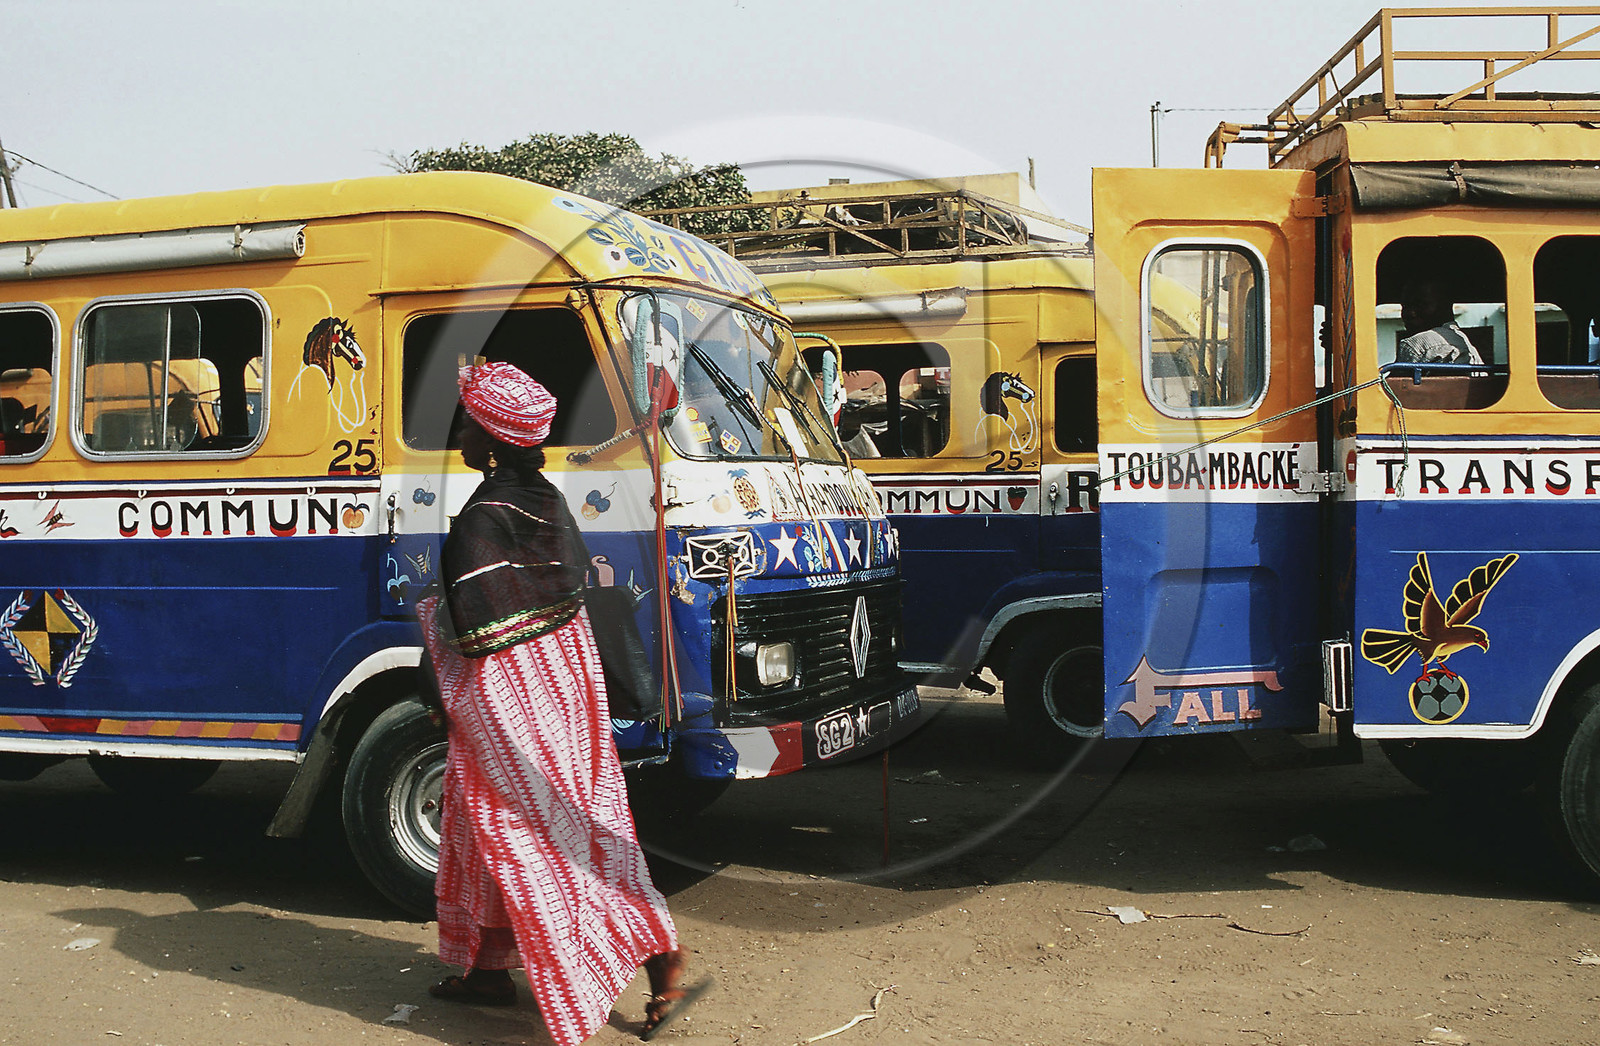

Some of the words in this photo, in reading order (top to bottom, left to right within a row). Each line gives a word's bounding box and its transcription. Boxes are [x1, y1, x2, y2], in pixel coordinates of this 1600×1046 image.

[329, 439, 377, 475] 25
[985, 450, 1023, 472] 25
[118, 498, 338, 537] COMMUN
[875, 489, 1002, 515] MMUN
[1116, 654, 1284, 732] FALL
